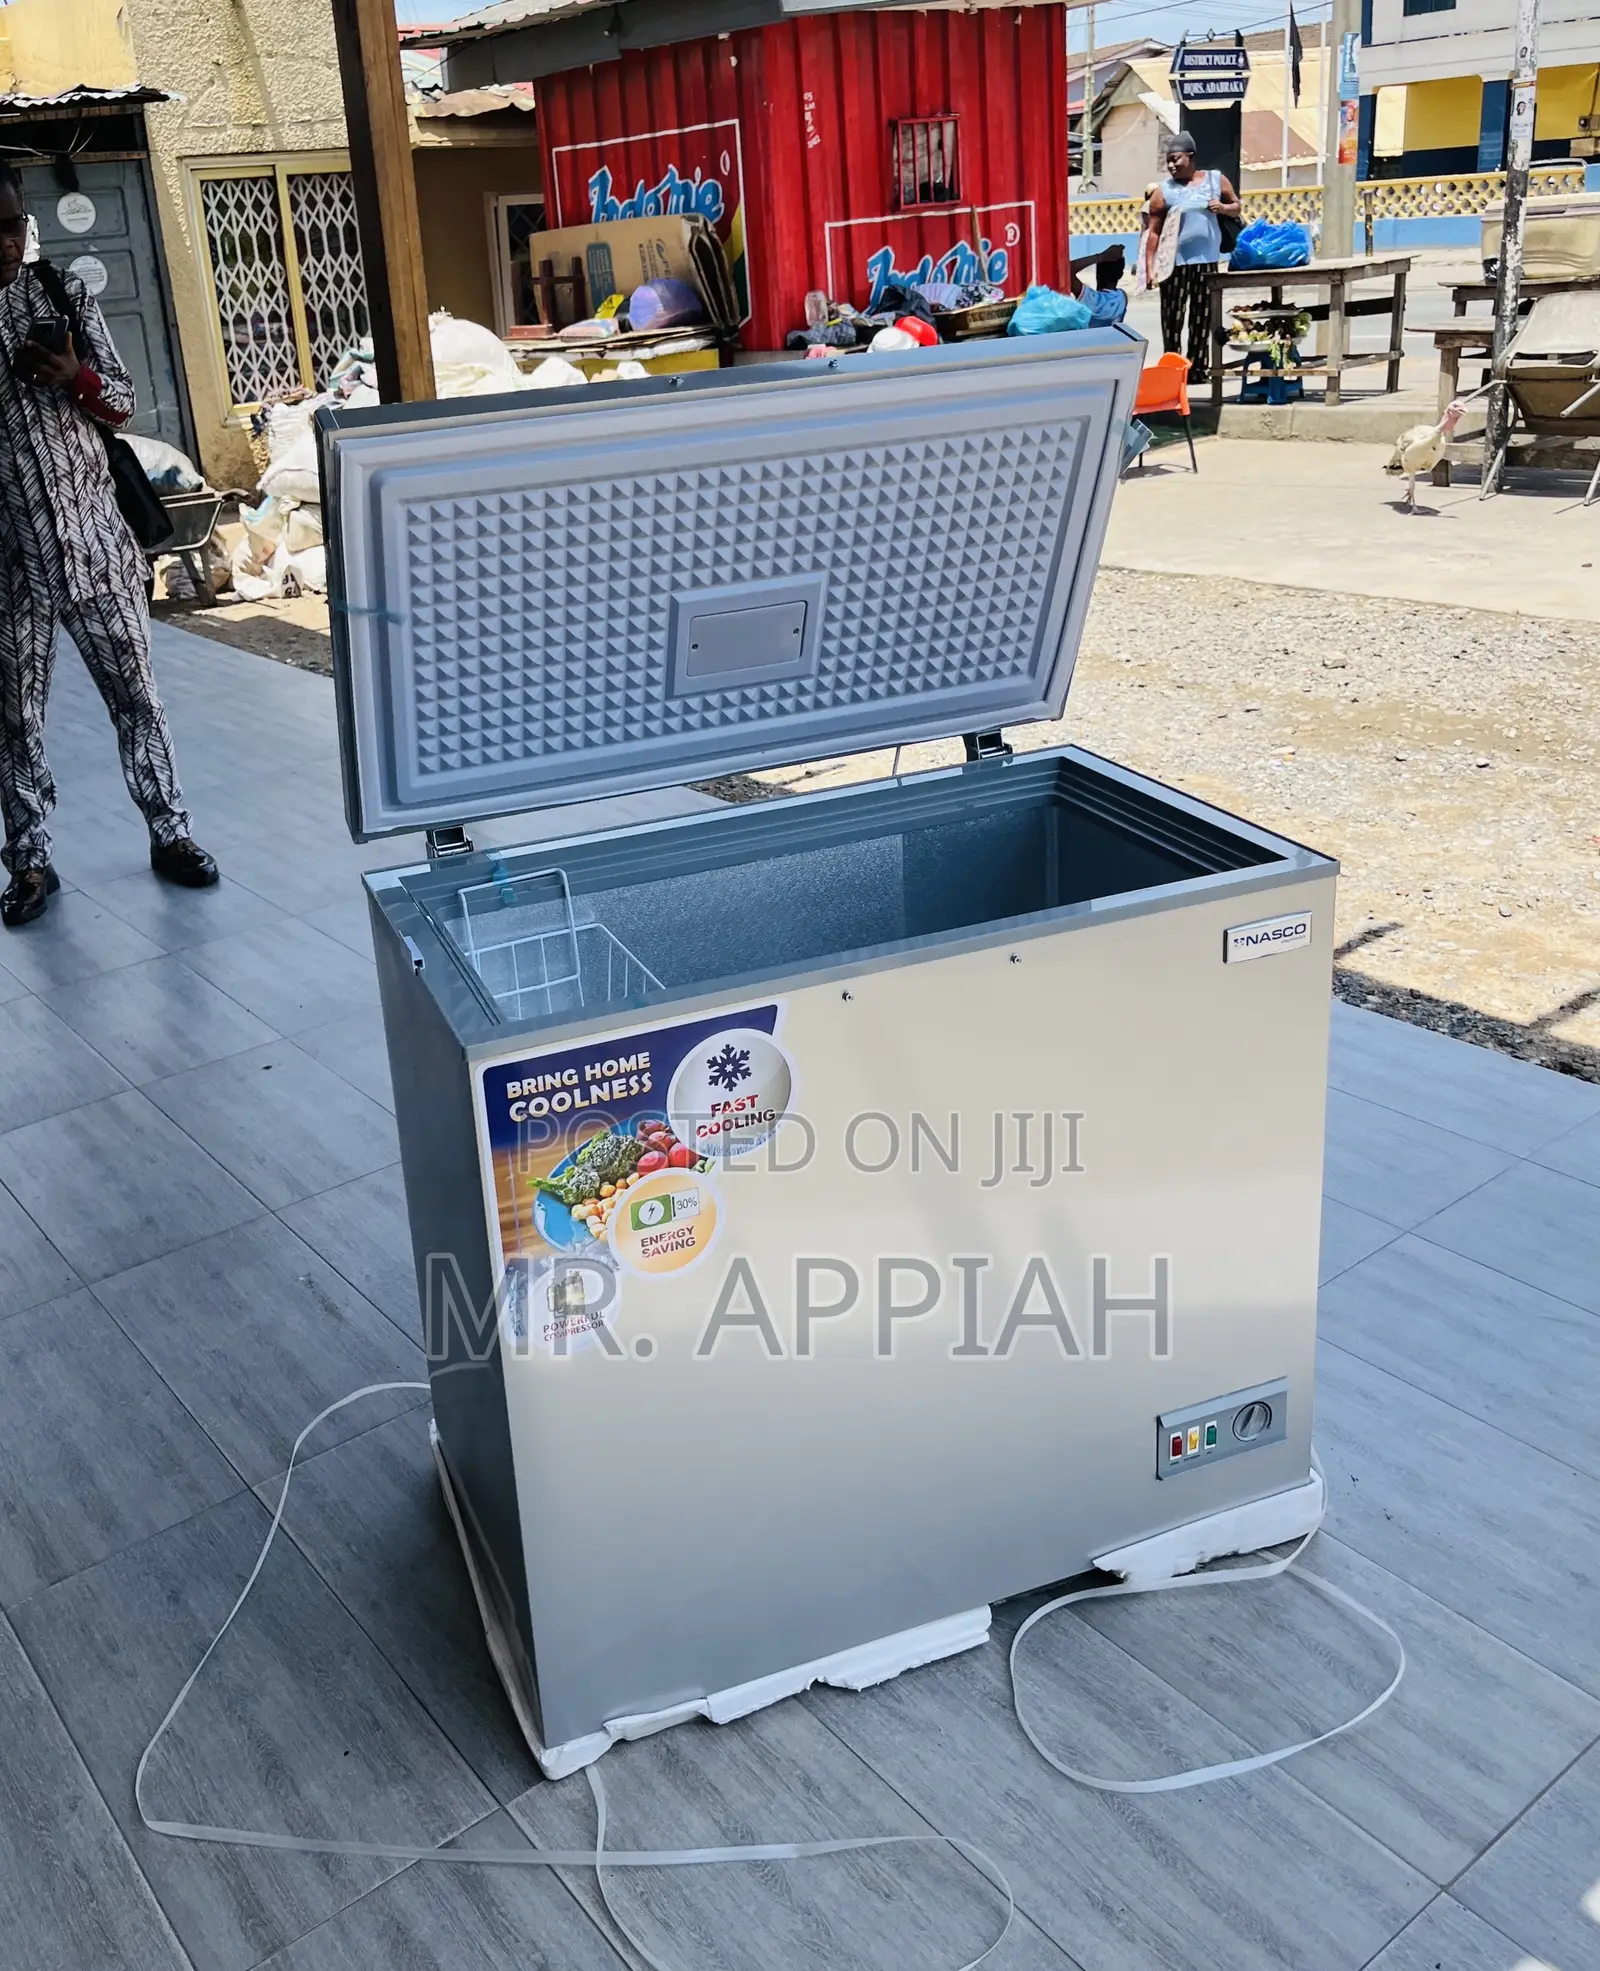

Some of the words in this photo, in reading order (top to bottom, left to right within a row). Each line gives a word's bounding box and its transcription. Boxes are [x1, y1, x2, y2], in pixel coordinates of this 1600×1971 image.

[1183, 54, 1213, 66] DISTRICT
[1213, 54, 1238, 66] POLICE
[1206, 81, 1244, 94] ADABRAKA
[1245, 923, 1307, 946] NASCO
[506, 1067, 579, 1100] BRING
[584, 1051, 652, 1082] HOME
[508, 1071, 653, 1123] COOLNESS
[710, 1094, 759, 1118] FAST
[695, 1109, 776, 1139] COOLING
[676, 1196, 698, 1211] 30%
[640, 1226, 696, 1249] ENERGY
[641, 1236, 697, 1259] SAVING
[542, 1310, 606, 1334] POWERFUL
[543, 1319, 606, 1342] COMPRESSOR
